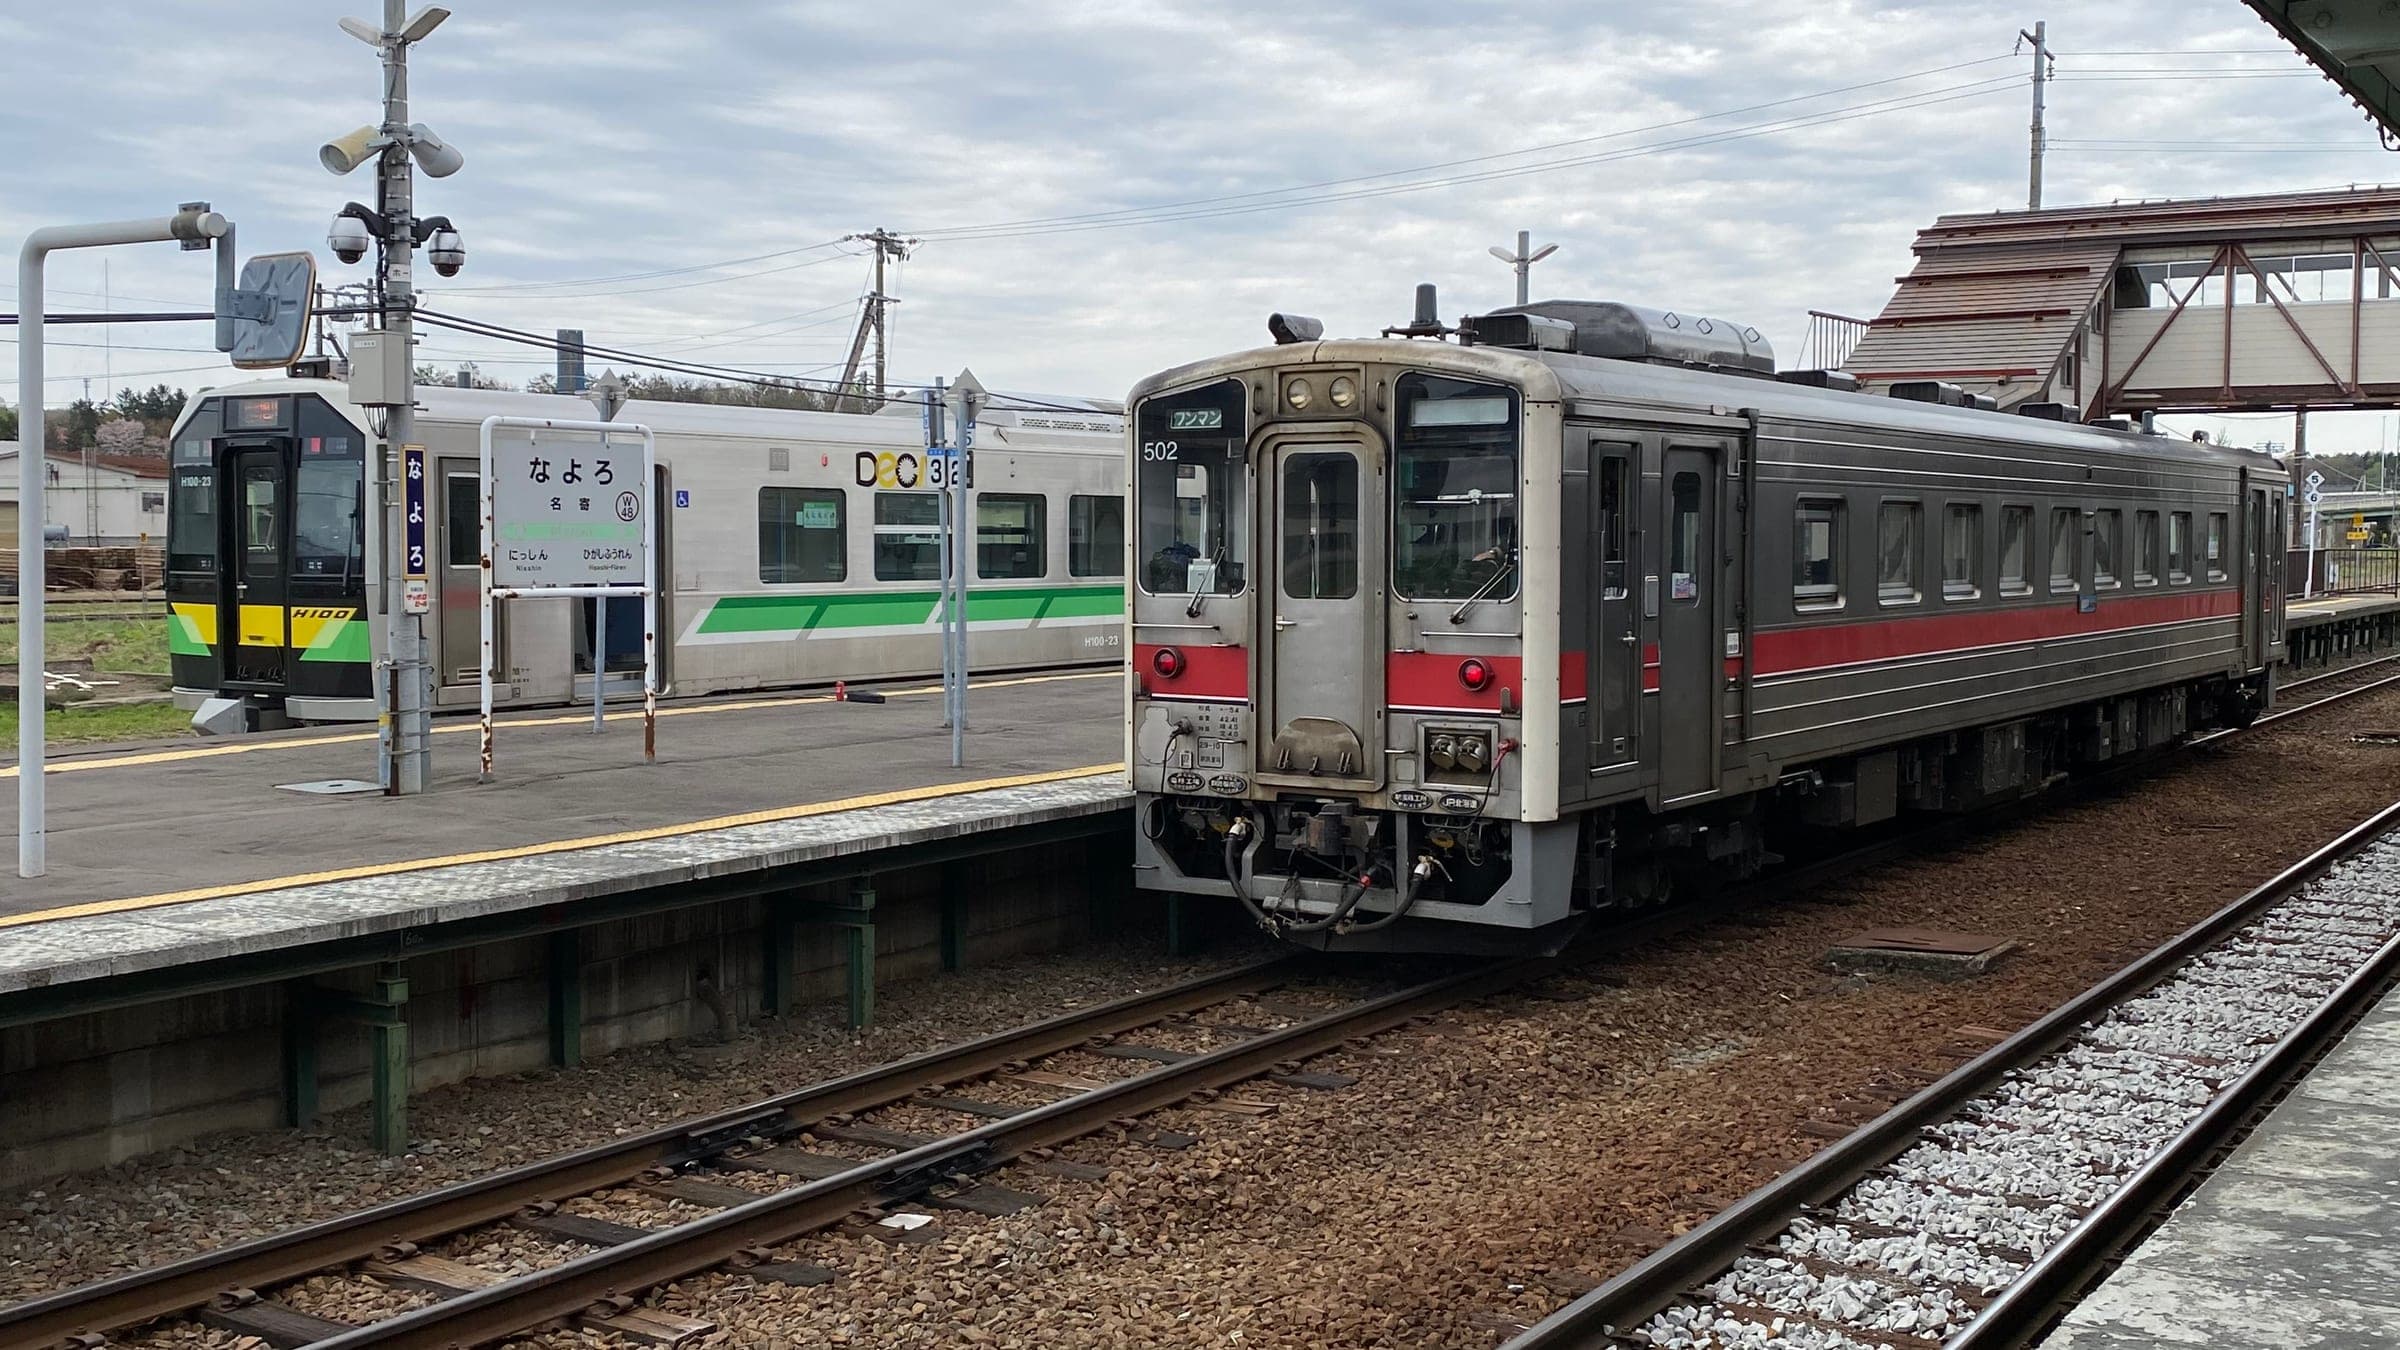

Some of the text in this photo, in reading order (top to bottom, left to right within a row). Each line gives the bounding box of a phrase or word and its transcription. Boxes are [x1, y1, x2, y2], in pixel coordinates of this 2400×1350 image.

[1174, 411, 1222, 426] ワンマン
[1143, 441, 1179, 461] 502
[529, 456, 614, 486] なよろ
[930, 458, 942, 483] 3
[181, 476, 212, 487] H100-23
[2311, 475, 2319, 484] 5
[622, 496, 633, 507] W
[2310, 493, 2318, 502] 6
[550, 496, 590, 512] 名寄
[407, 458, 424, 568] なよろ
[621, 507, 634, 518] 48
[508, 549, 549, 561] にっしん
[582, 548, 634, 560] ひがしふうれん
[292, 609, 351, 619] H100
[1084, 635, 1119, 647] H100-23
